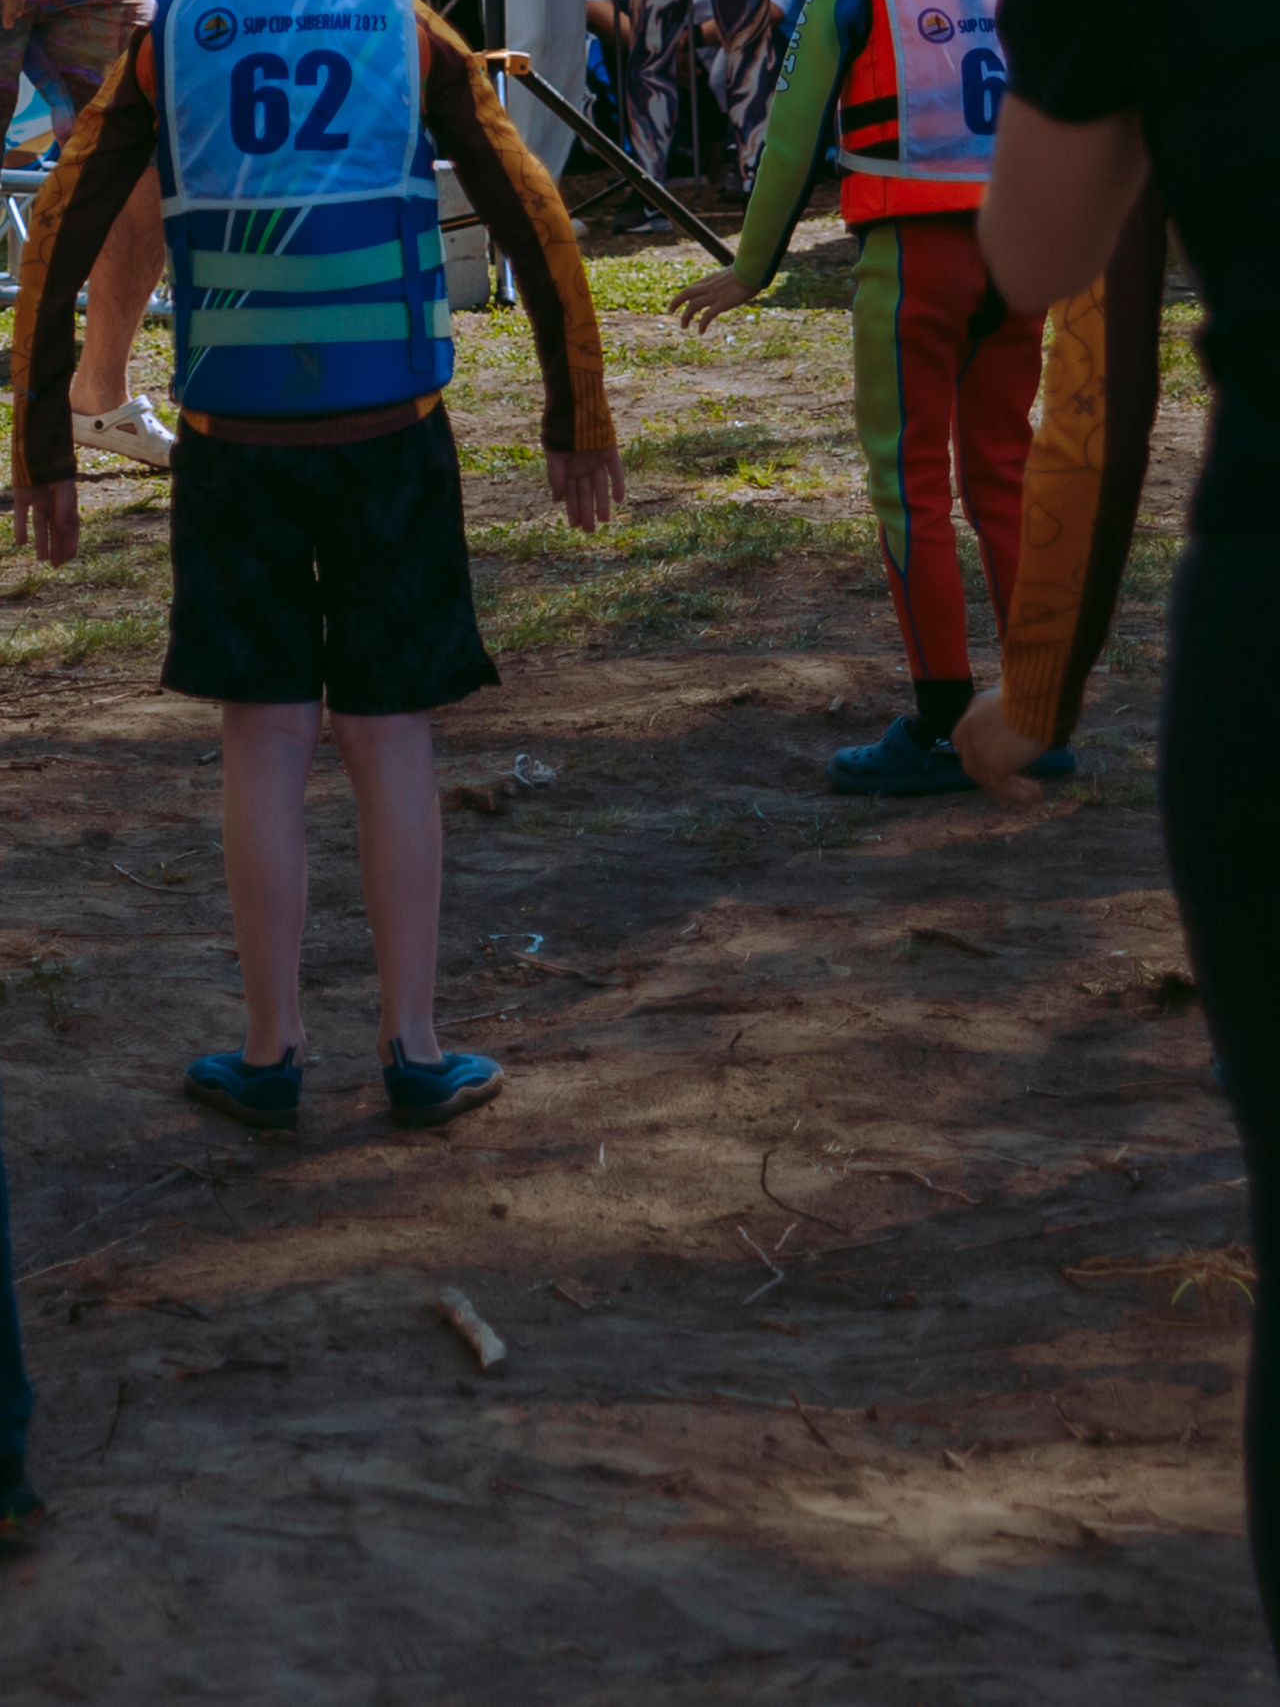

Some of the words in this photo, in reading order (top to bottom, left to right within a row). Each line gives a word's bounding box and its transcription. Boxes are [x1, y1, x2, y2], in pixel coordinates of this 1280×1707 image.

[242, 16, 268, 36] SUP
[269, 14, 294, 34] CUP
[295, 13, 352, 33] SIBERIAN
[354, 13, 388, 32] 2023
[956, 19, 978, 34] SUP
[978, 17, 997, 33] CUP
[228, 48, 353, 156] 62
